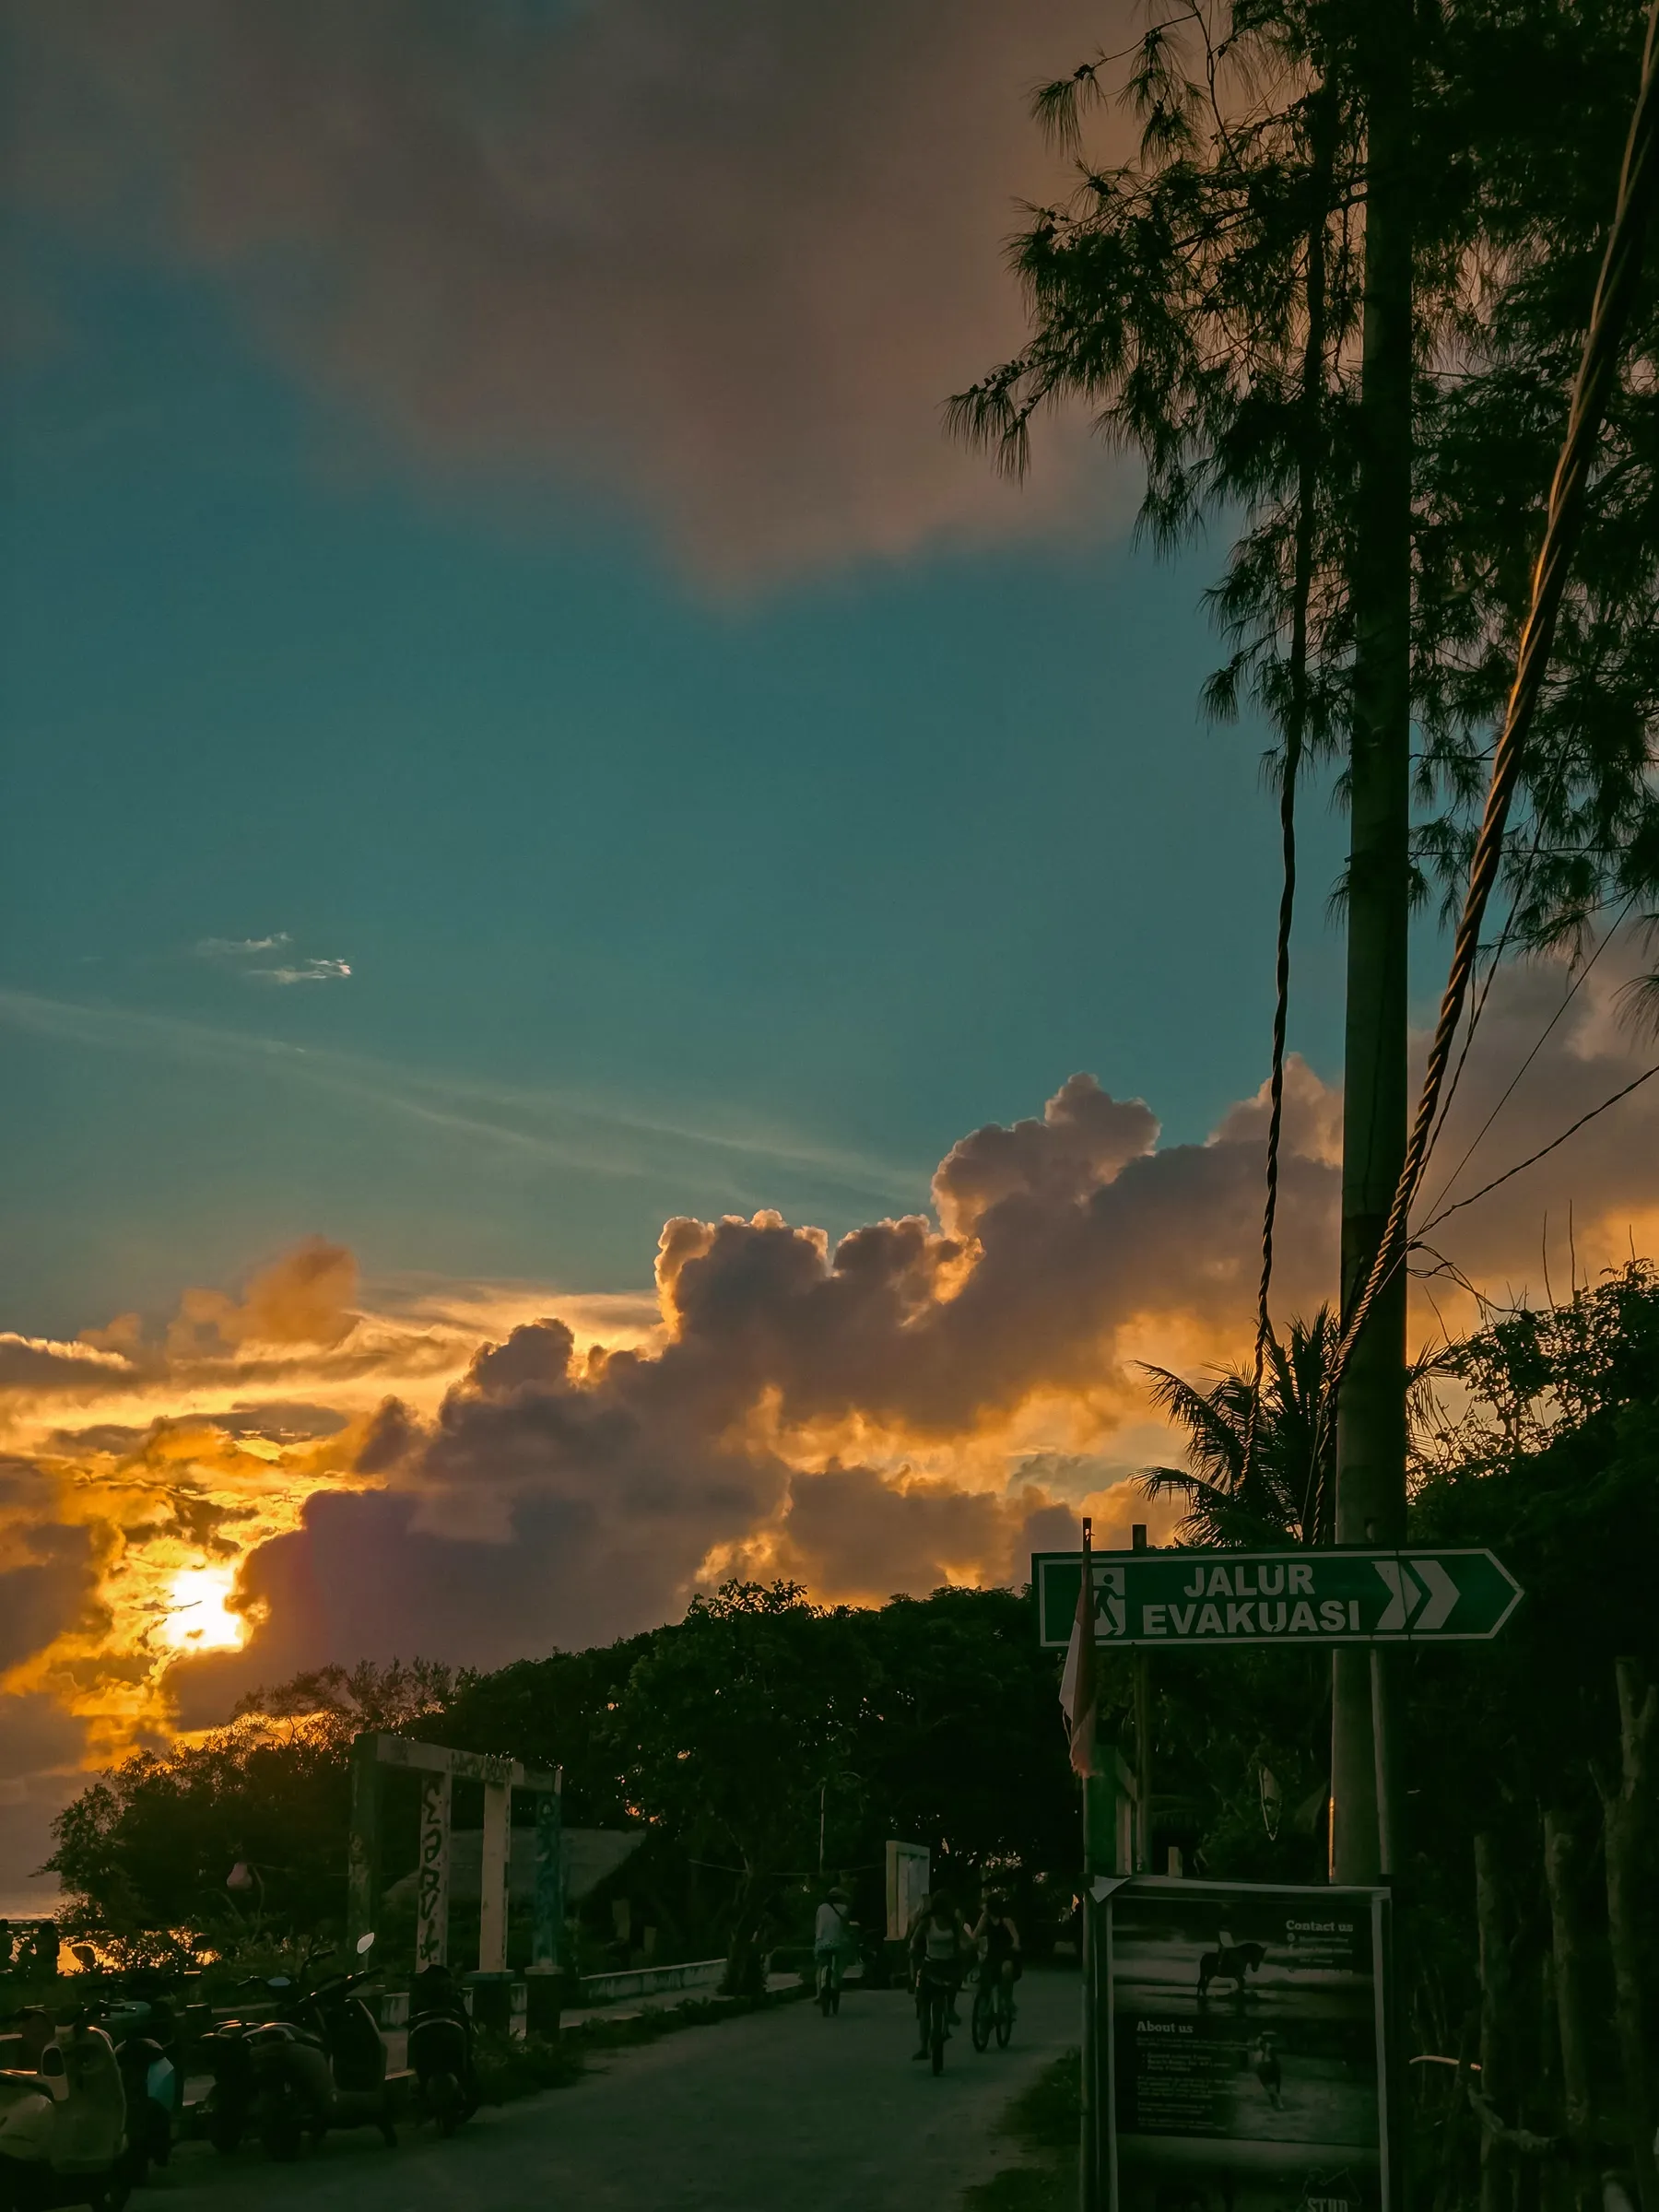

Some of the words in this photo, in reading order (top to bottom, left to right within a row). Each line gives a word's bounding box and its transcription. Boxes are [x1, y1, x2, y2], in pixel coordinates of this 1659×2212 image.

[1183, 1563, 1316, 1597] JALUR
[1142, 1599, 1360, 1635] EVAKUASI
[1285, 1919, 1335, 1933] Contact
[1338, 1924, 1354, 1933] us
[1135, 2019, 1176, 2033] About
[1178, 2024, 1194, 2033] us
